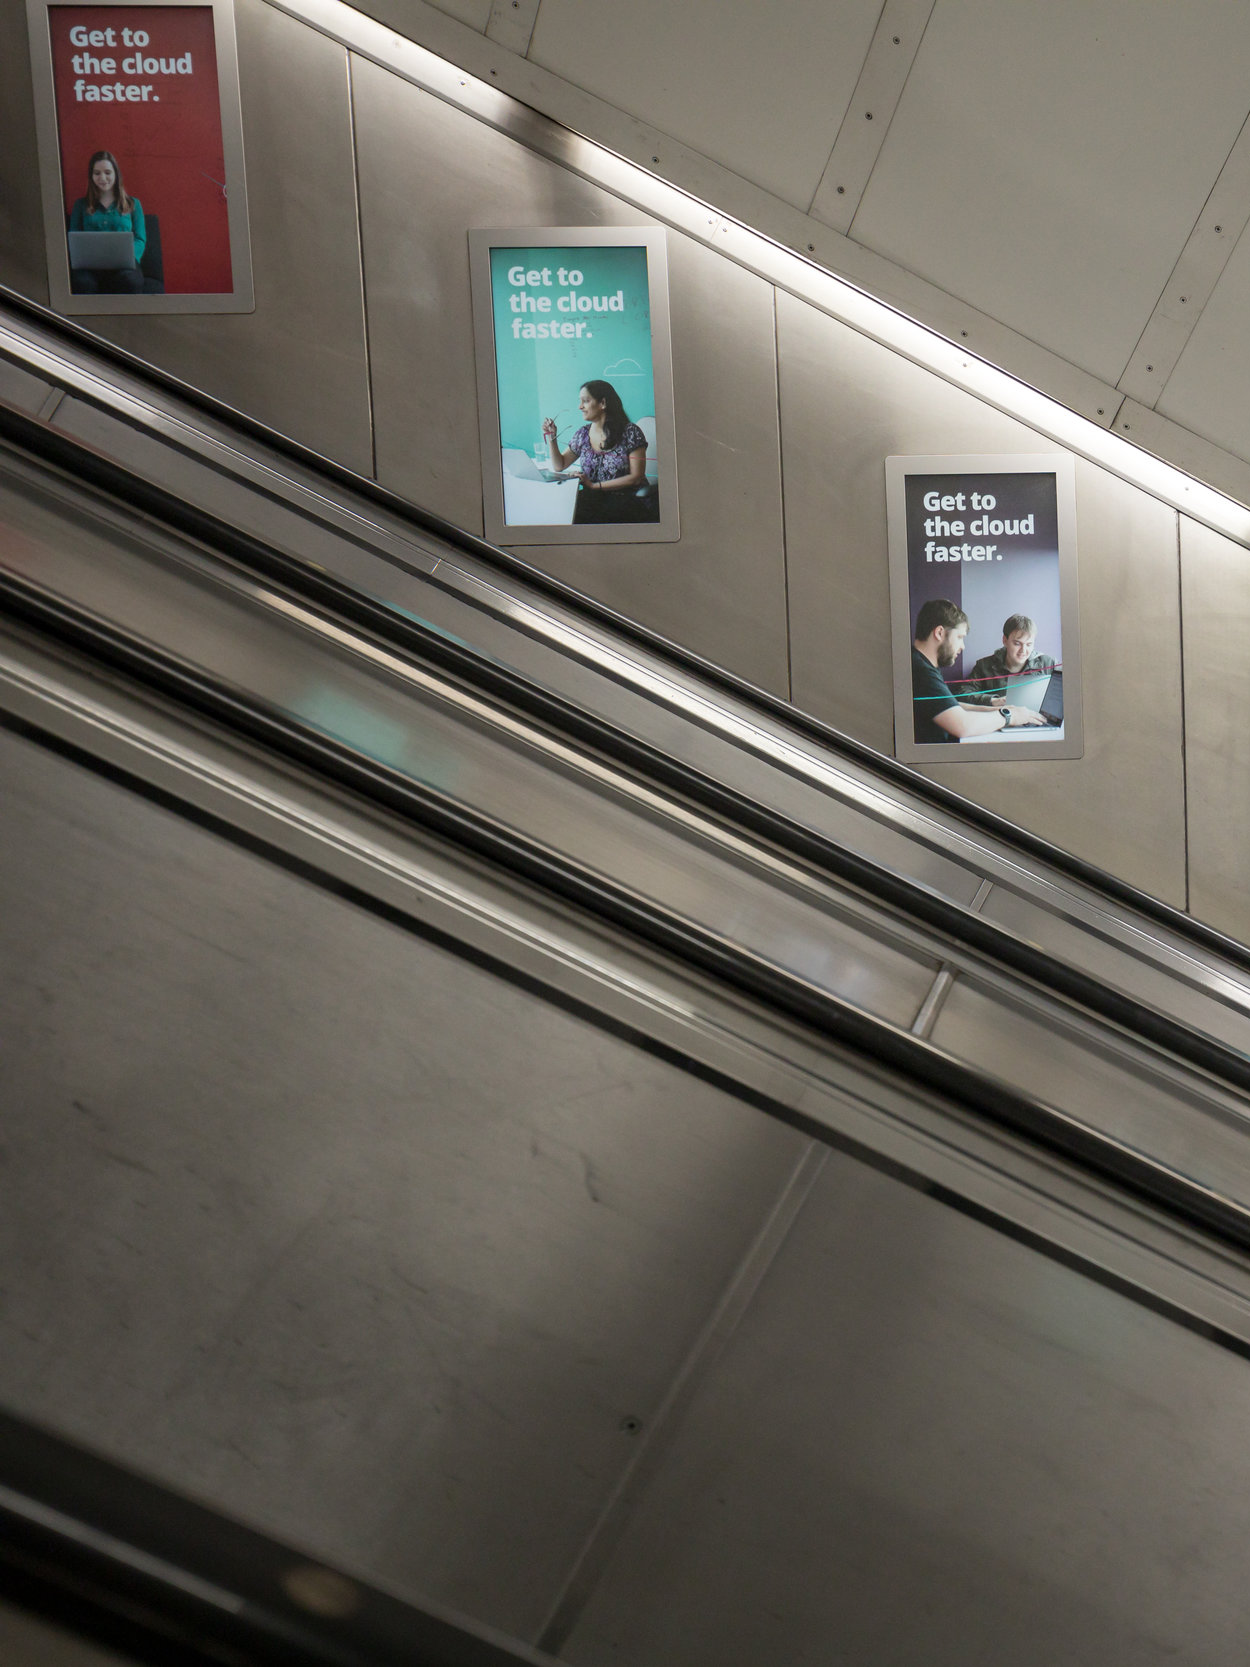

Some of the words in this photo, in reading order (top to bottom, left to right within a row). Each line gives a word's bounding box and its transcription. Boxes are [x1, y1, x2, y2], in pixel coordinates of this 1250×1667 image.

[69, 25, 117, 48] Get
[120, 27, 150, 48] to
[71, 53, 117, 75] the
[122, 53, 193, 75] cloud
[73, 80, 160, 102] faster.
[507, 266, 553, 287] Get
[556, 267, 584, 287] to
[508, 291, 552, 313] the
[556, 290, 625, 313] cloud
[511, 317, 593, 339] faster.
[923, 491, 967, 512] Get
[970, 492, 997, 512] to
[923, 515, 966, 537] the
[969, 514, 1035, 537] cloud
[924, 541, 1004, 563] faster.
